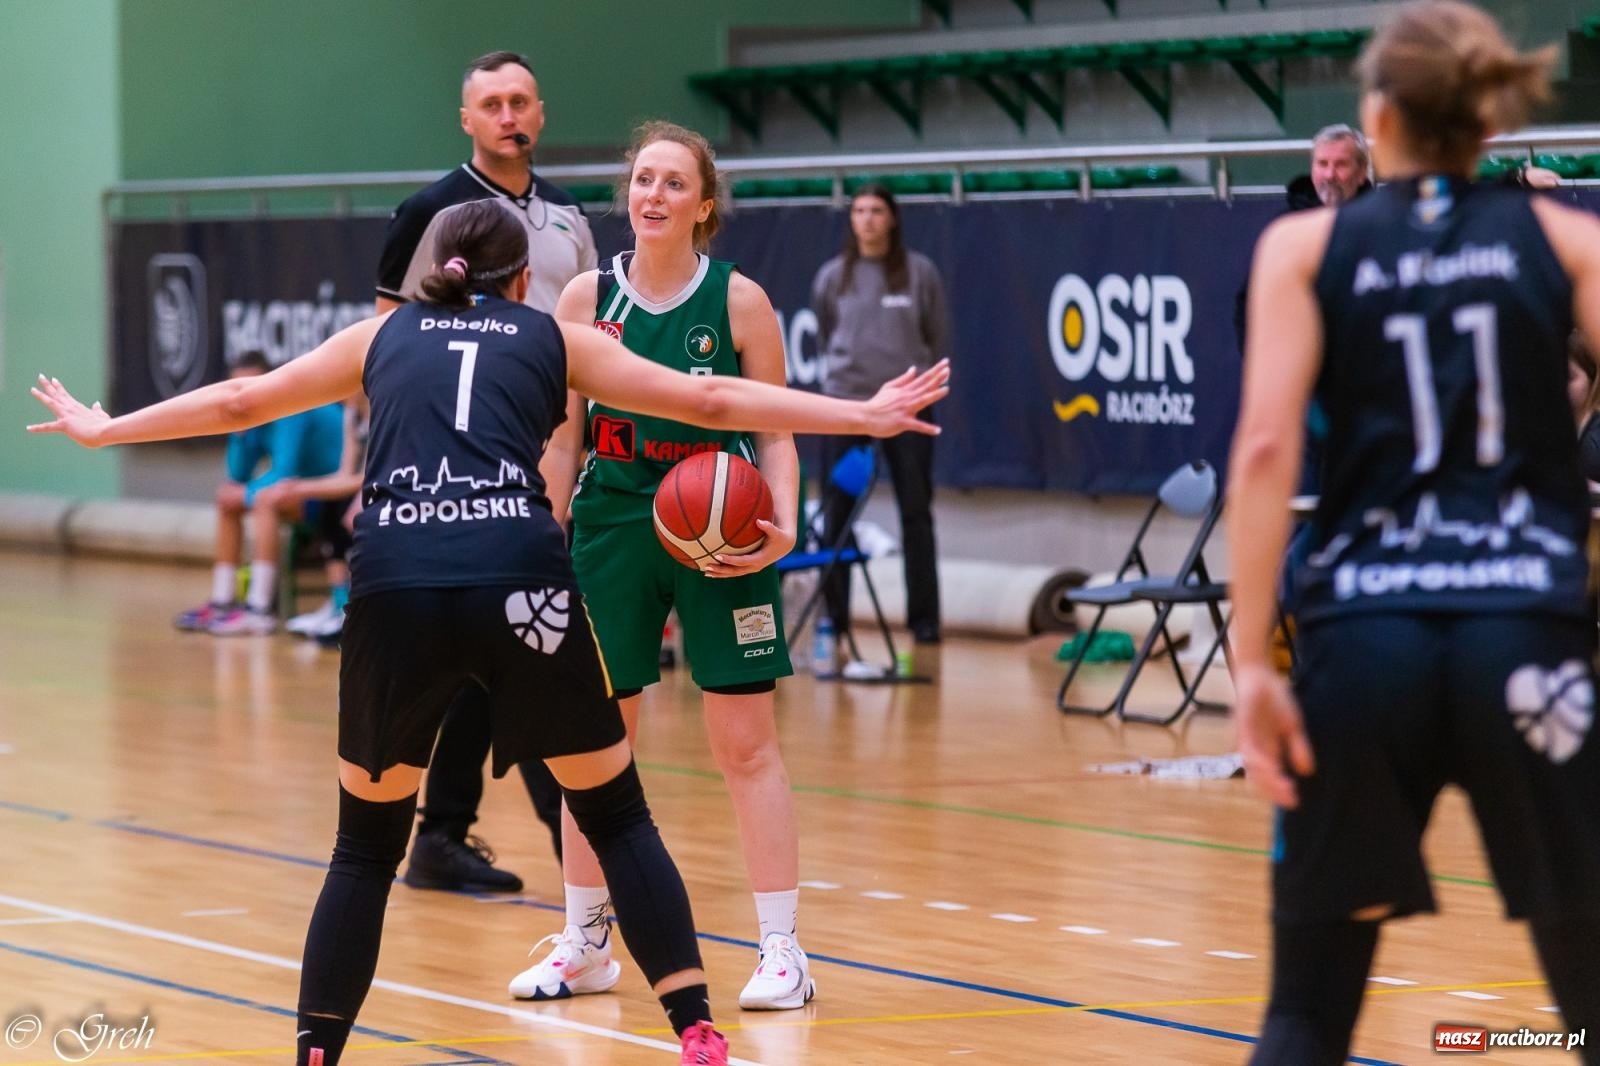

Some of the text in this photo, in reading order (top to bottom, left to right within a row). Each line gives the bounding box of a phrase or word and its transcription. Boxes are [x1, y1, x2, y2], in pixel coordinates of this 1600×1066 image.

[420, 317, 519, 335] Dobejko
[1106, 384, 1195, 425] RACIBÓRZ
[395, 497, 532, 525] OPOLSKIE
[743, 646, 775, 658] COLO
